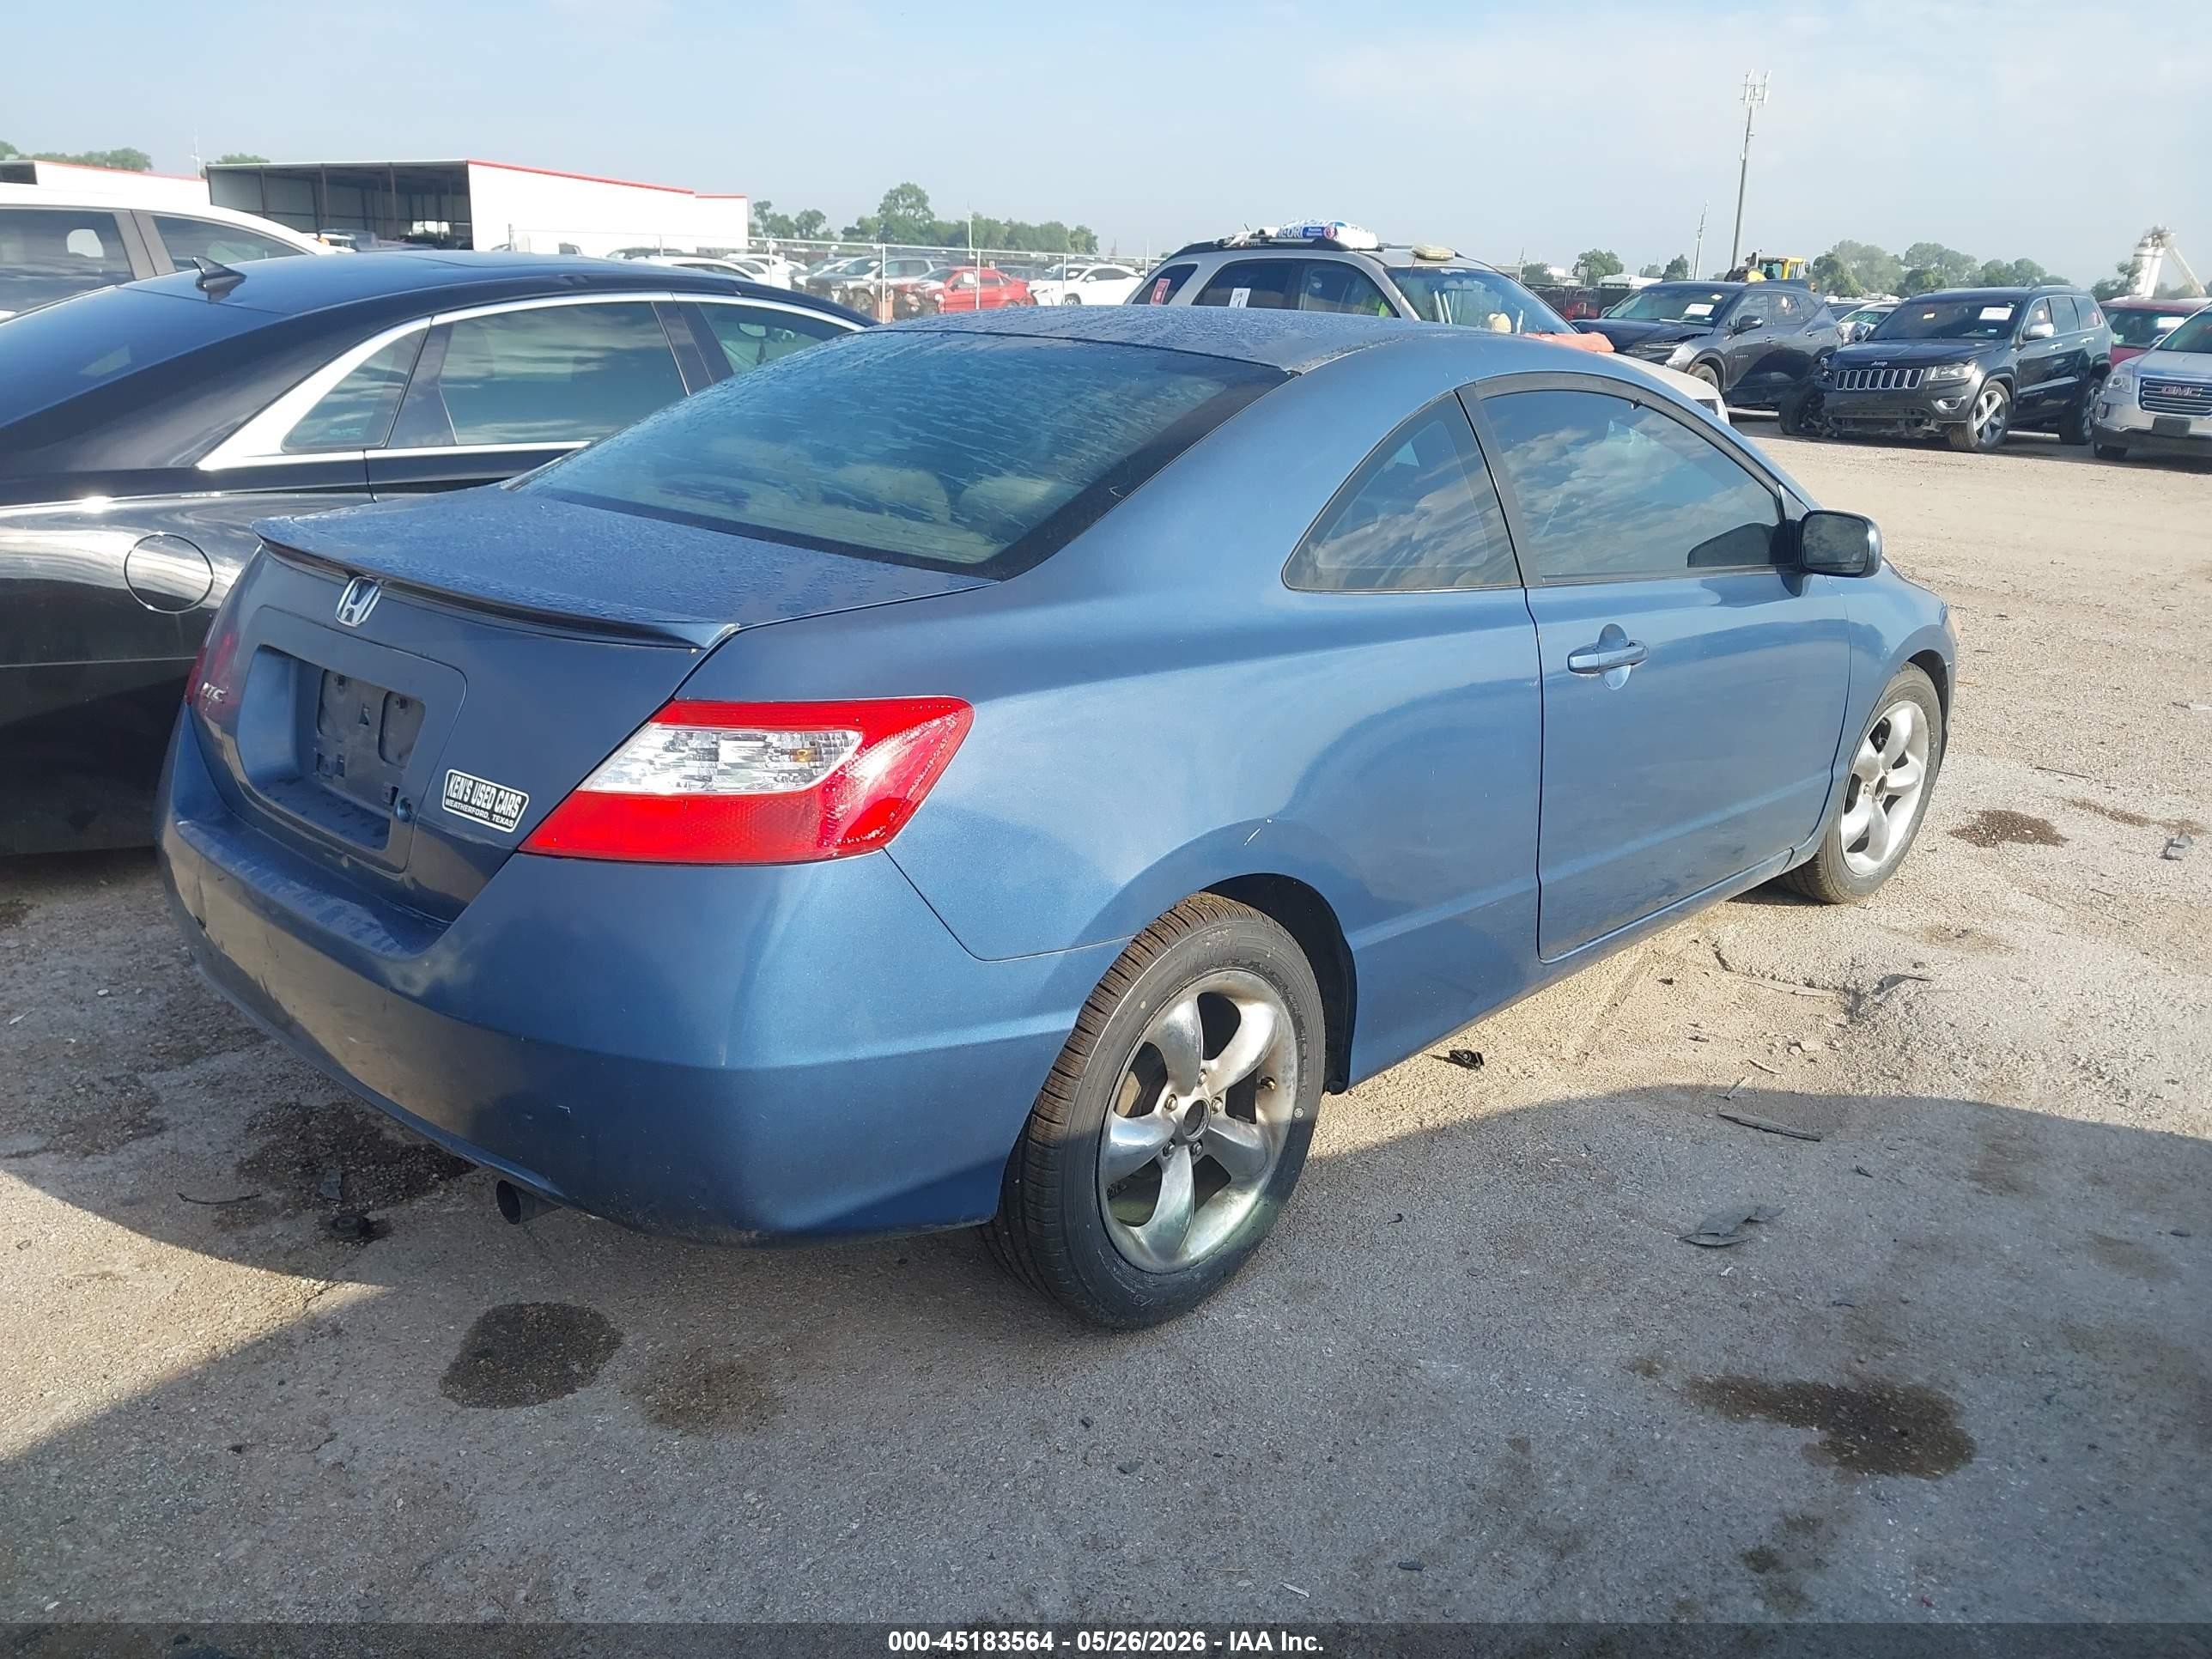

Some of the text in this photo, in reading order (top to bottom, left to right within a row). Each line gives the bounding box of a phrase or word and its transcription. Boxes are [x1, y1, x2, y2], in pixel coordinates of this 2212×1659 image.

[2161, 385, 2203, 398] GMC
[447, 774, 522, 819] KEN'S USED CARS
[445, 798, 515, 828] WEATHERFORD, TEXAS
